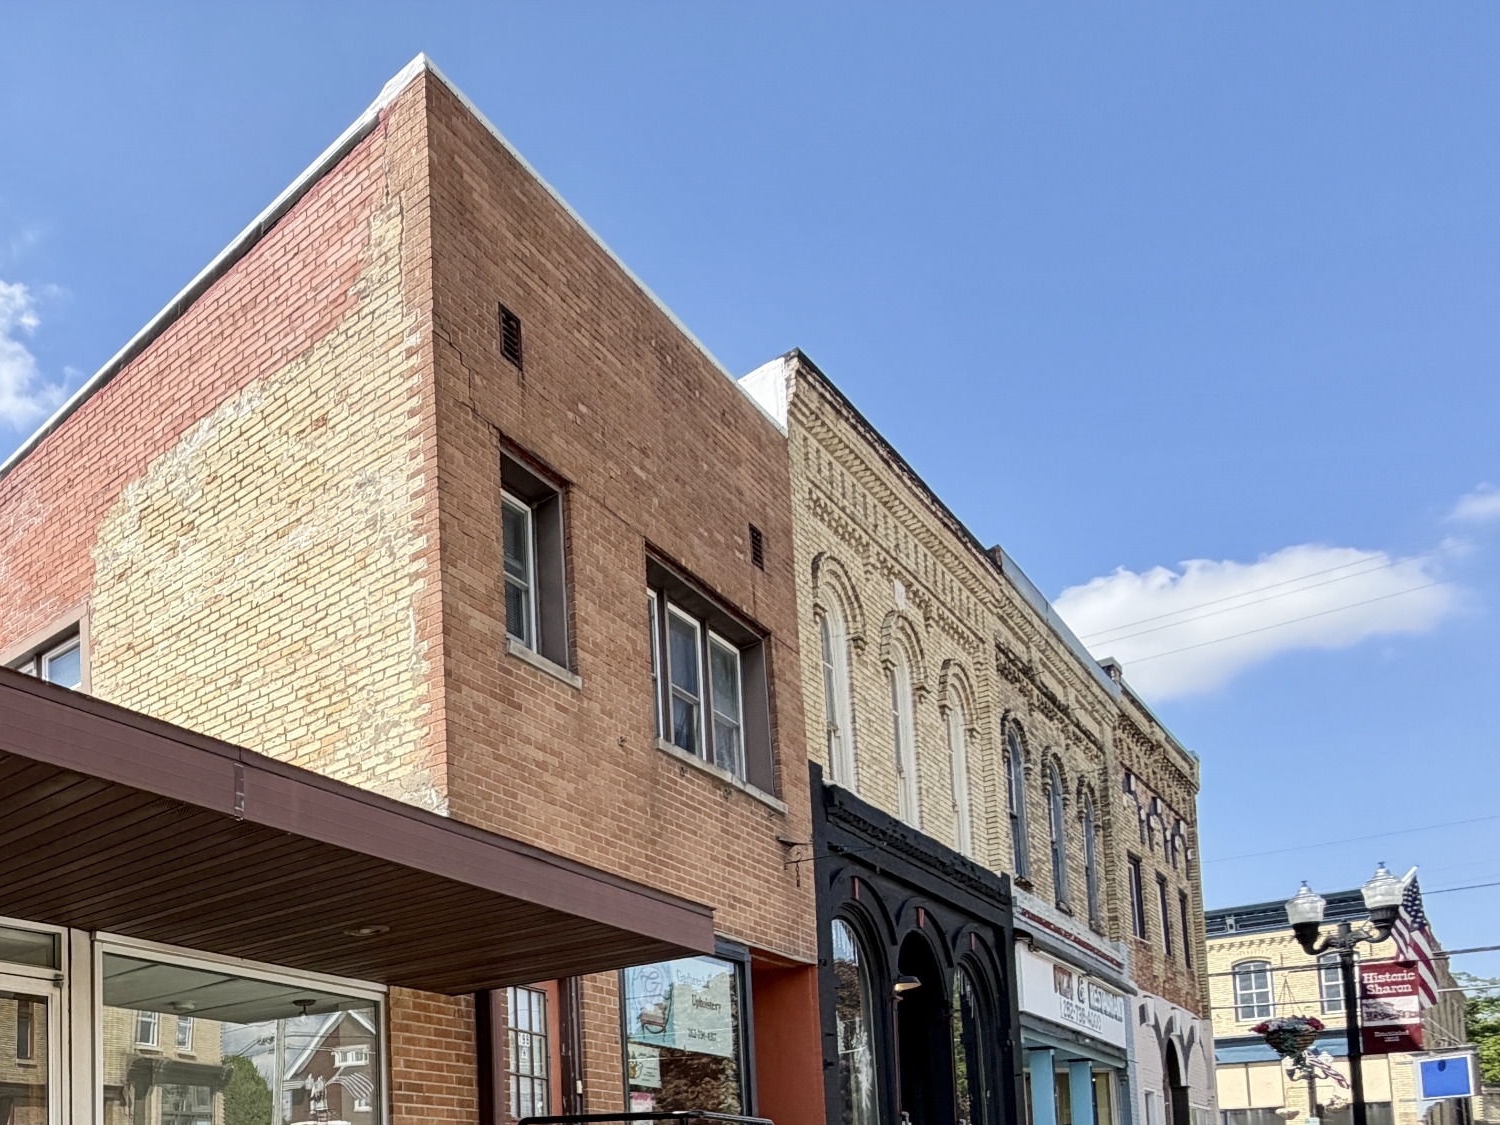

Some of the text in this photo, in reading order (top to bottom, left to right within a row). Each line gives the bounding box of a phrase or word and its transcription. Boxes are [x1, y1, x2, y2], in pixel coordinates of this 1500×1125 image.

[1362, 969, 1416, 984] Historic
[1077, 975, 1085, 1005] &
[1366, 984, 1413, 995] Sharon
[691, 993, 722, 1014] Upholstery
